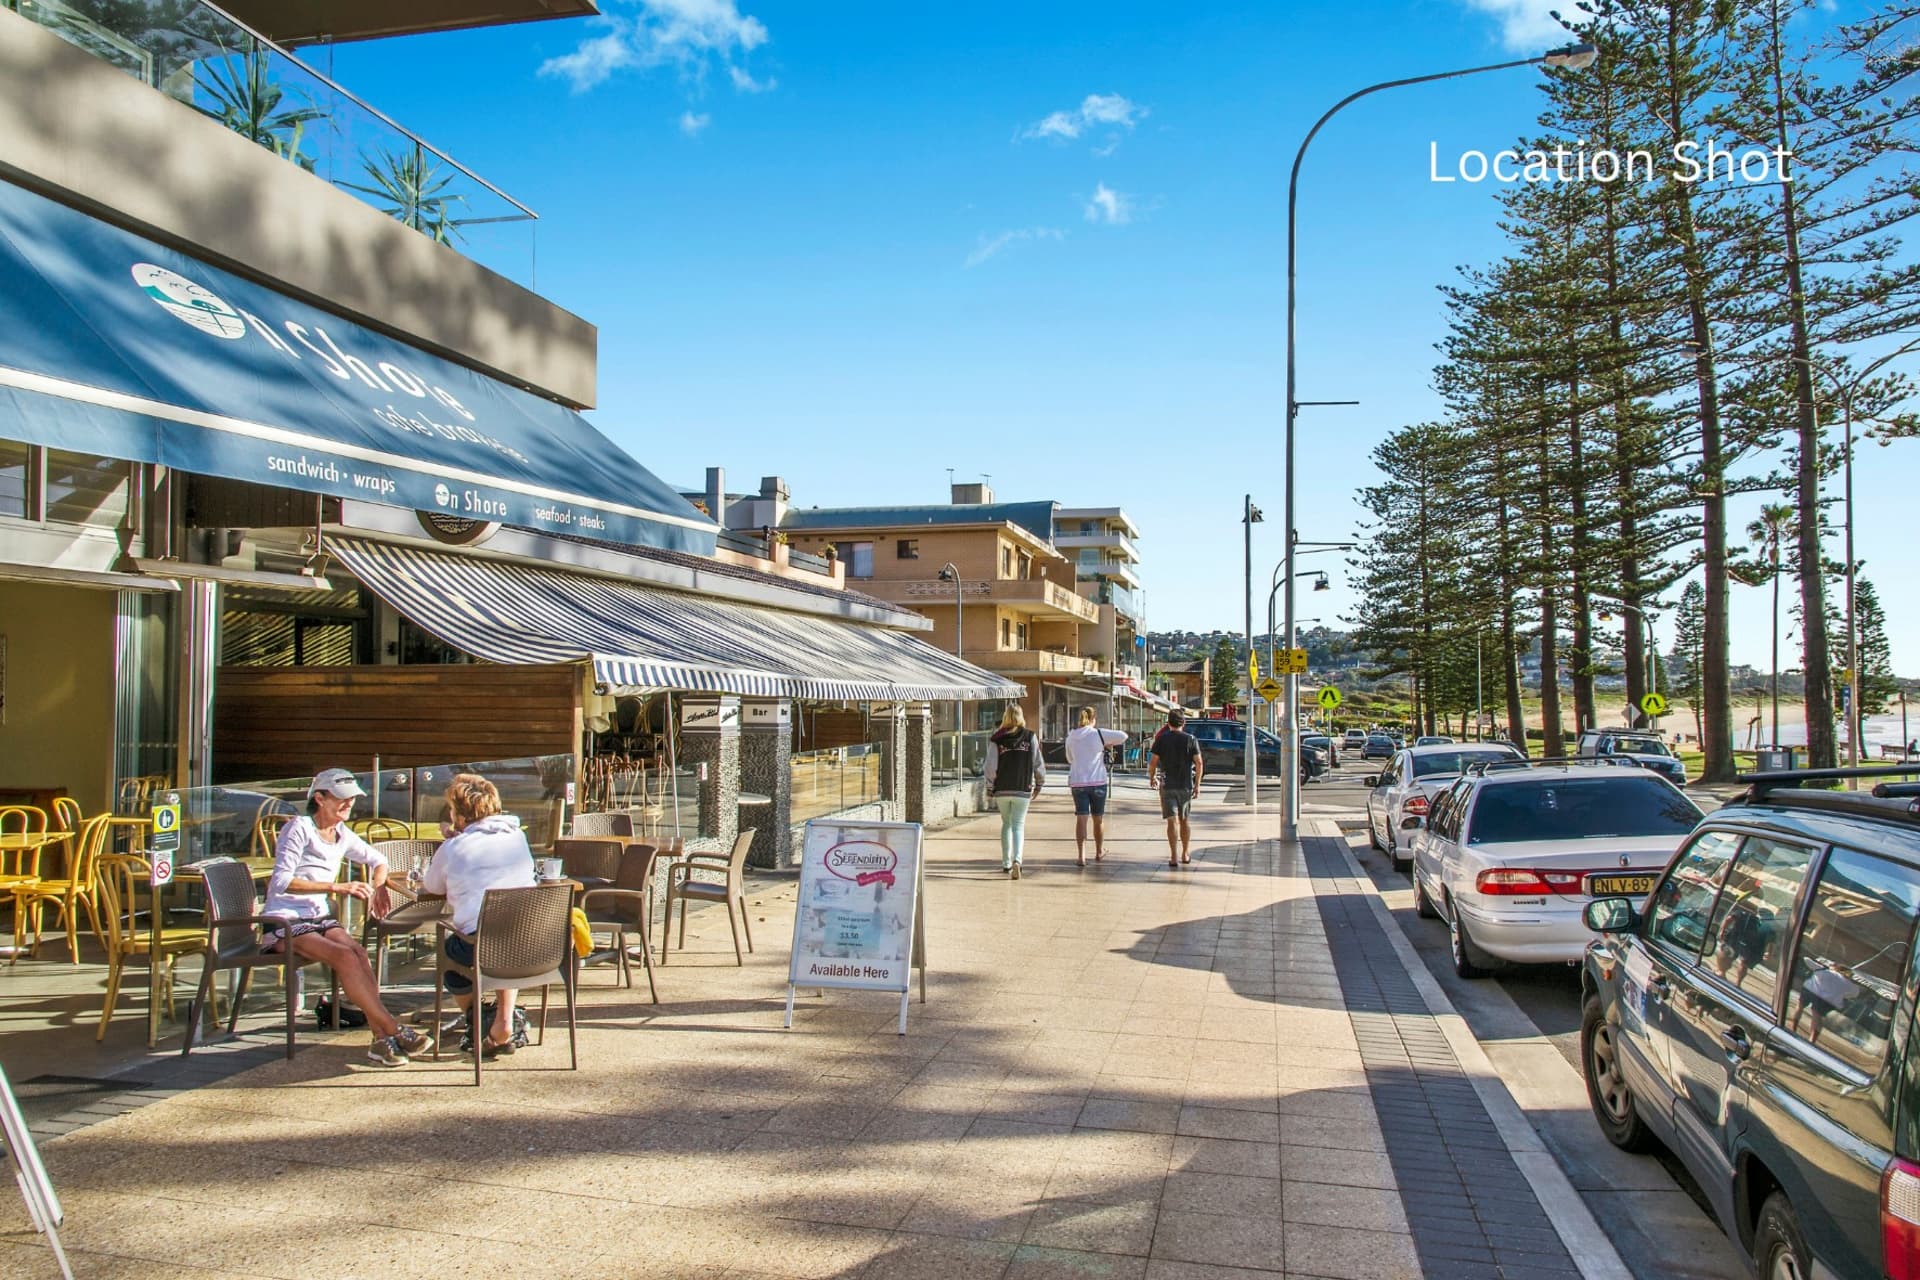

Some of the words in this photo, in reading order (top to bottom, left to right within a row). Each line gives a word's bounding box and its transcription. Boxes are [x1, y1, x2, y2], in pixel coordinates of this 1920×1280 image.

[284, 320, 476, 422] Shore
[267, 455, 339, 483] sandwich
[353, 472, 396, 495] wraps
[464, 490, 508, 517] Shore
[535, 505, 571, 525] seafood
[579, 515, 606, 531] steaks
[752, 708, 768, 716] Bar
[809, 962, 860, 978] Available
[863, 965, 889, 979] Here
